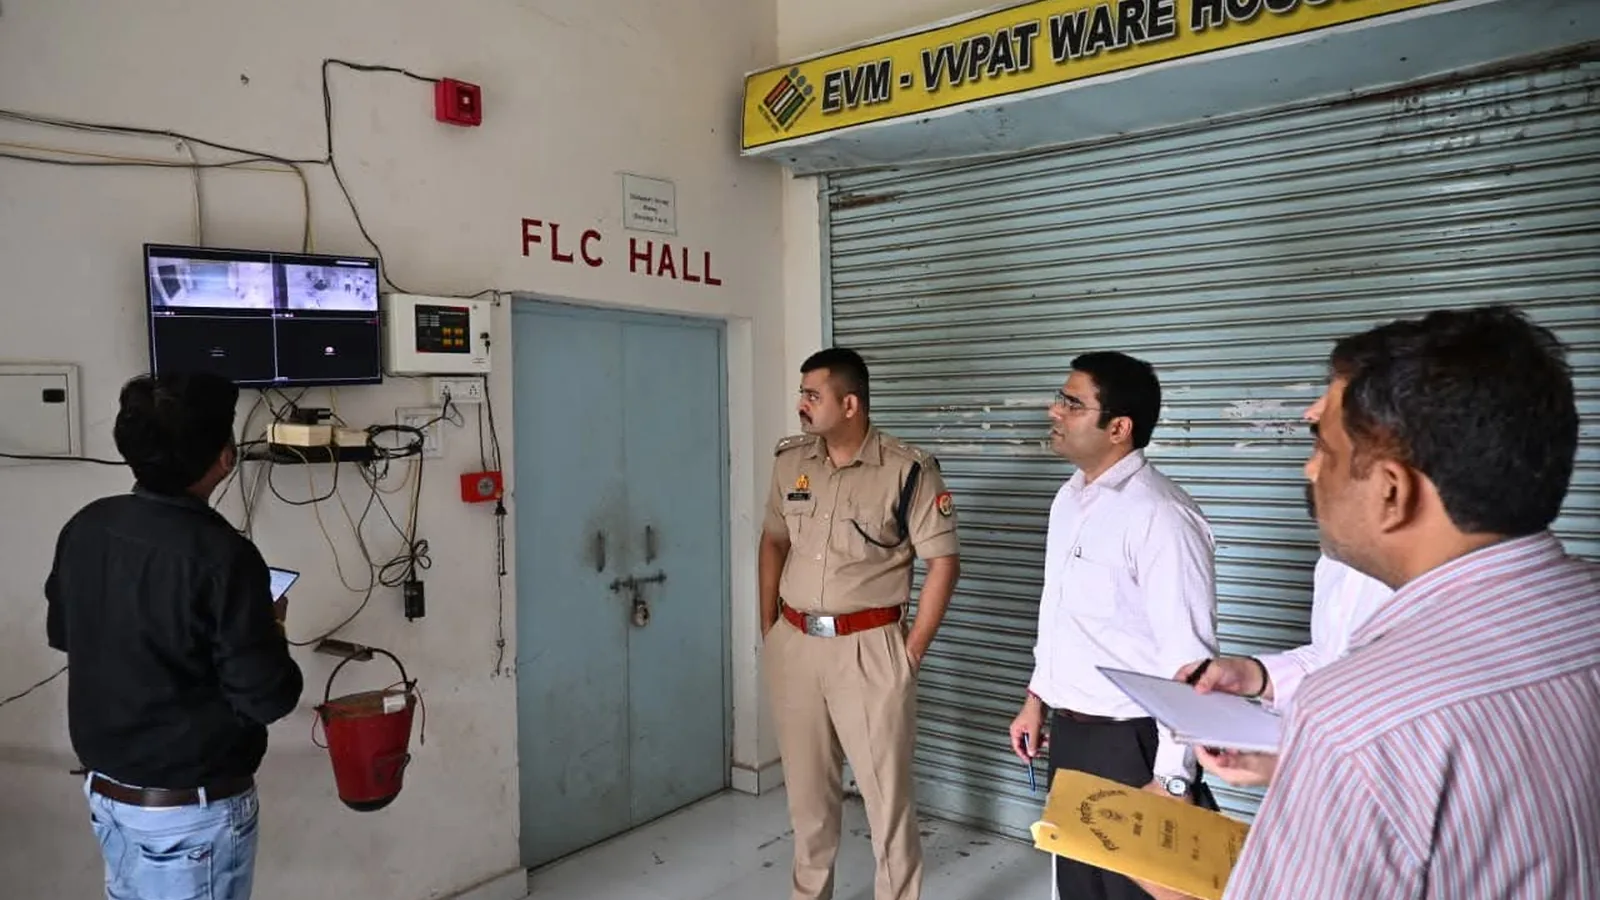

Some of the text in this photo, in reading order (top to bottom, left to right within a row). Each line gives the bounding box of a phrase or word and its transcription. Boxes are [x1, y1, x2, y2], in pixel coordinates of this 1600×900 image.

[821, 58, 892, 113] EVM
[920, 20, 1040, 91] VVPAT
[1049, 0, 1176, 63] WARE
[521, 218, 722, 286] FLC HALL
